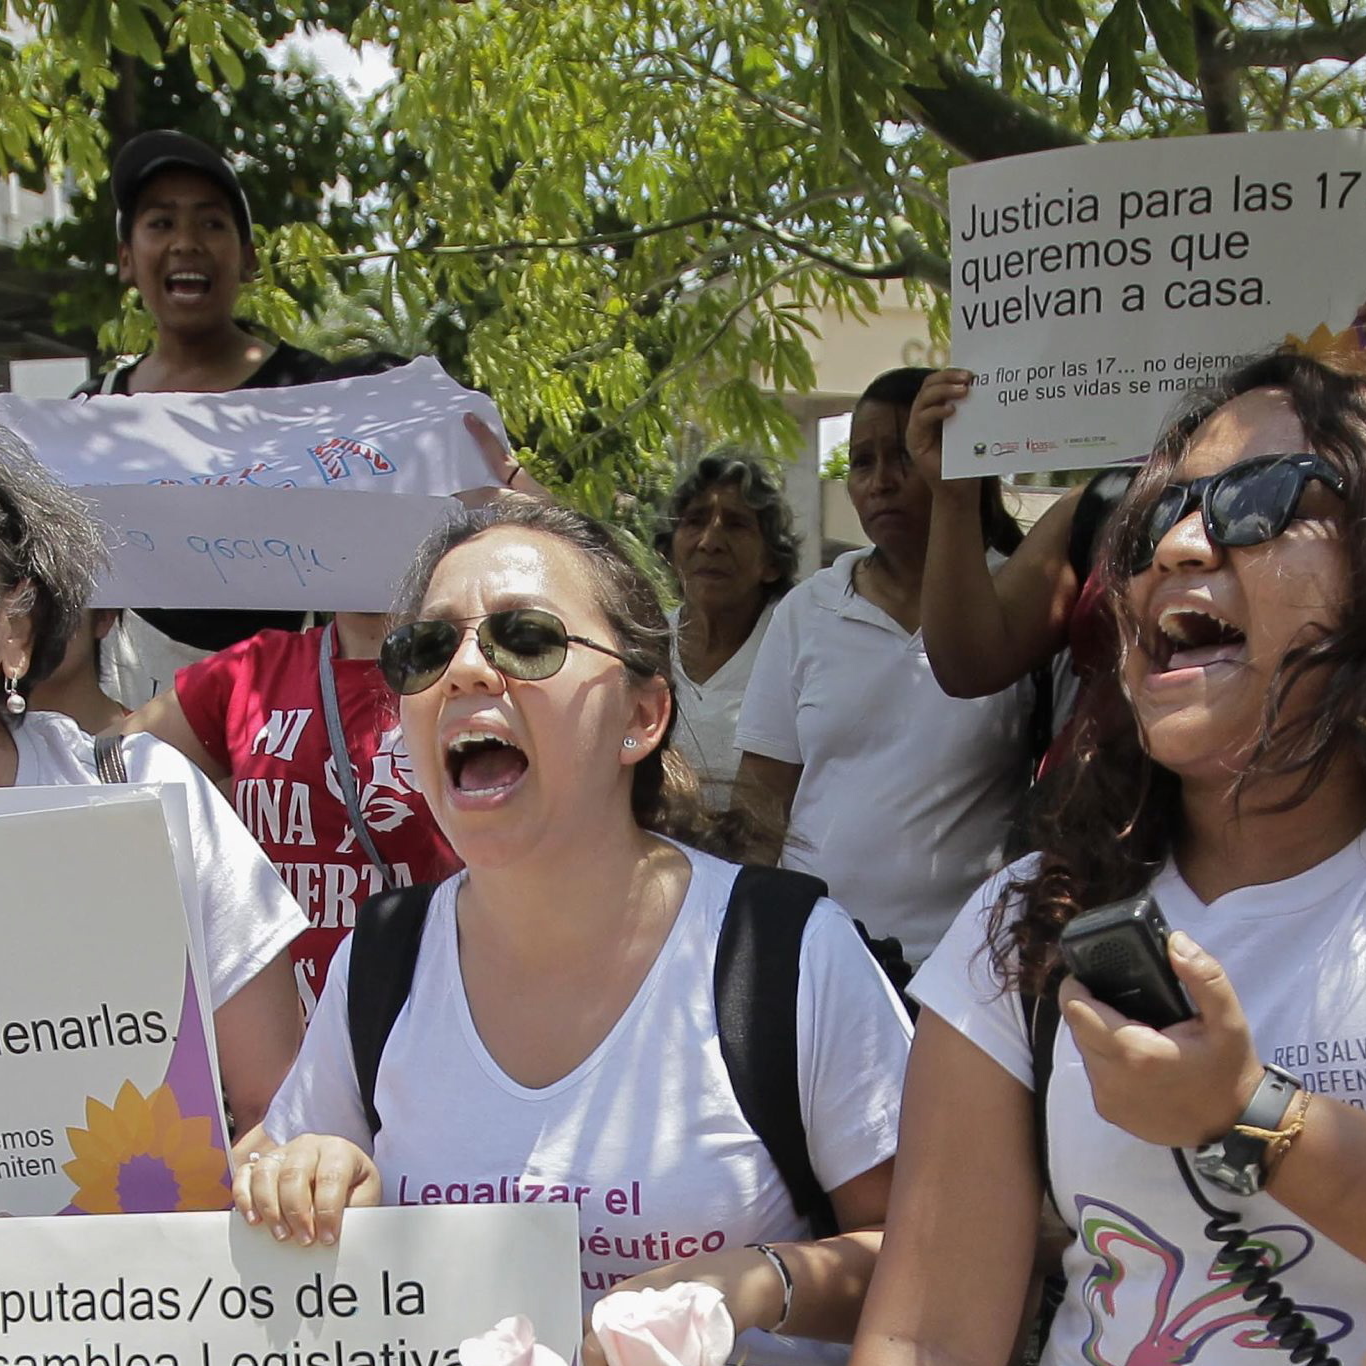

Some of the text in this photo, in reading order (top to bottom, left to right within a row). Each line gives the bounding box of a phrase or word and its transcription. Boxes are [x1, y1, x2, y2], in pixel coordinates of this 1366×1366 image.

[961, 187, 1099, 242] Justicia
[1119, 186, 1212, 230] para
[1233, 174, 1293, 213] las
[961, 231, 1250, 294] queremos que
[961, 277, 1271, 331] vuelvan a casa.
[996, 367, 1021, 384] flor
[1026, 365, 1056, 385] por
[1062, 360, 1088, 378] las
[1096, 357, 1135, 375] 17...
[1143, 358, 1167, 373] no
[997, 388, 1029, 407] que
[1035, 384, 1066, 400] sus
[1073, 378, 1121, 397] vidas
[1128, 380, 1151, 394] se
[251, 708, 313, 761] NI
[1274, 1045, 1310, 1068] RED
[398, 1174, 642, 1216] Legalizar el
[579, 1226, 726, 1261] éutico
[295, 1272, 358, 1319] de
[382, 1270, 425, 1316] la
